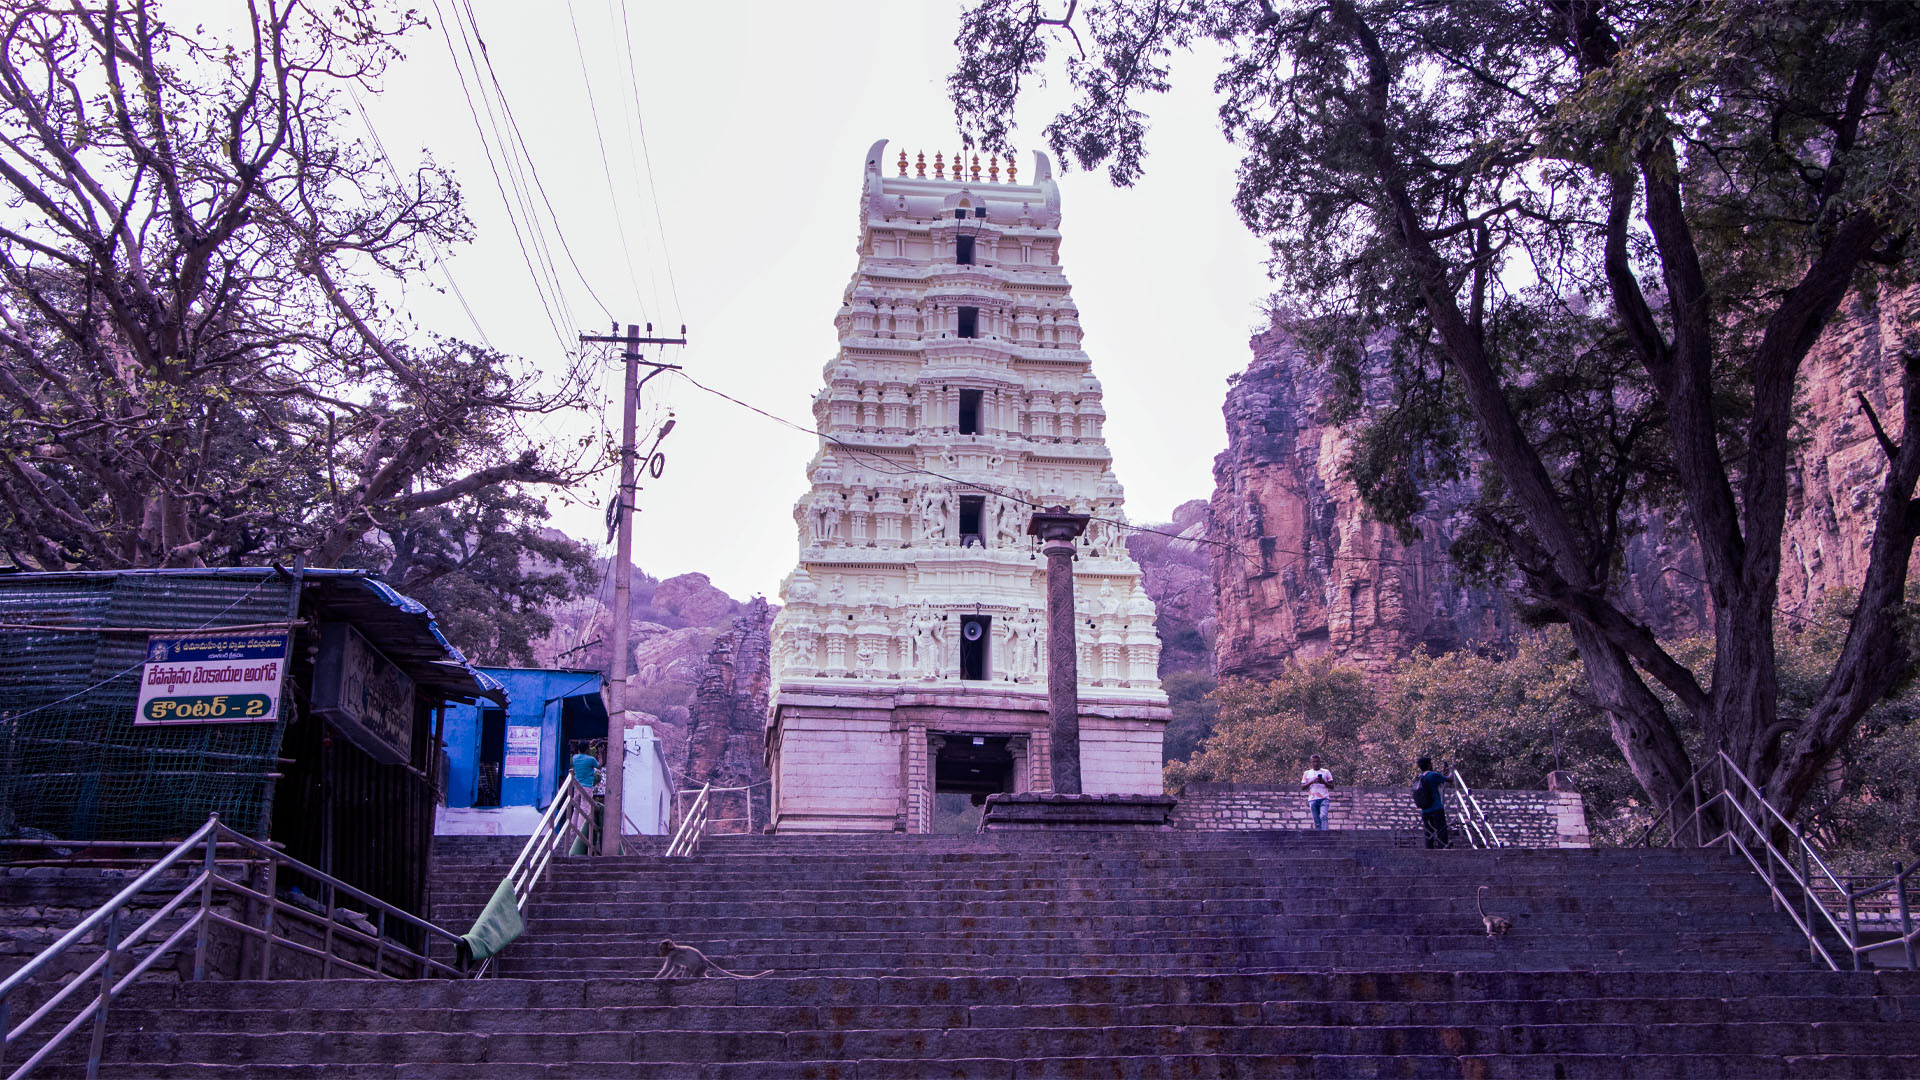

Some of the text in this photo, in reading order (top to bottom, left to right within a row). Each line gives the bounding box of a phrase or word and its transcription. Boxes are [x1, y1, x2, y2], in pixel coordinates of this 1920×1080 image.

[147, 662, 277, 694] దేవస్థానం టెంకాయల అంగడి
[151, 696, 229, 718] కౌంటర్
[245, 700, 264, 716] 2
